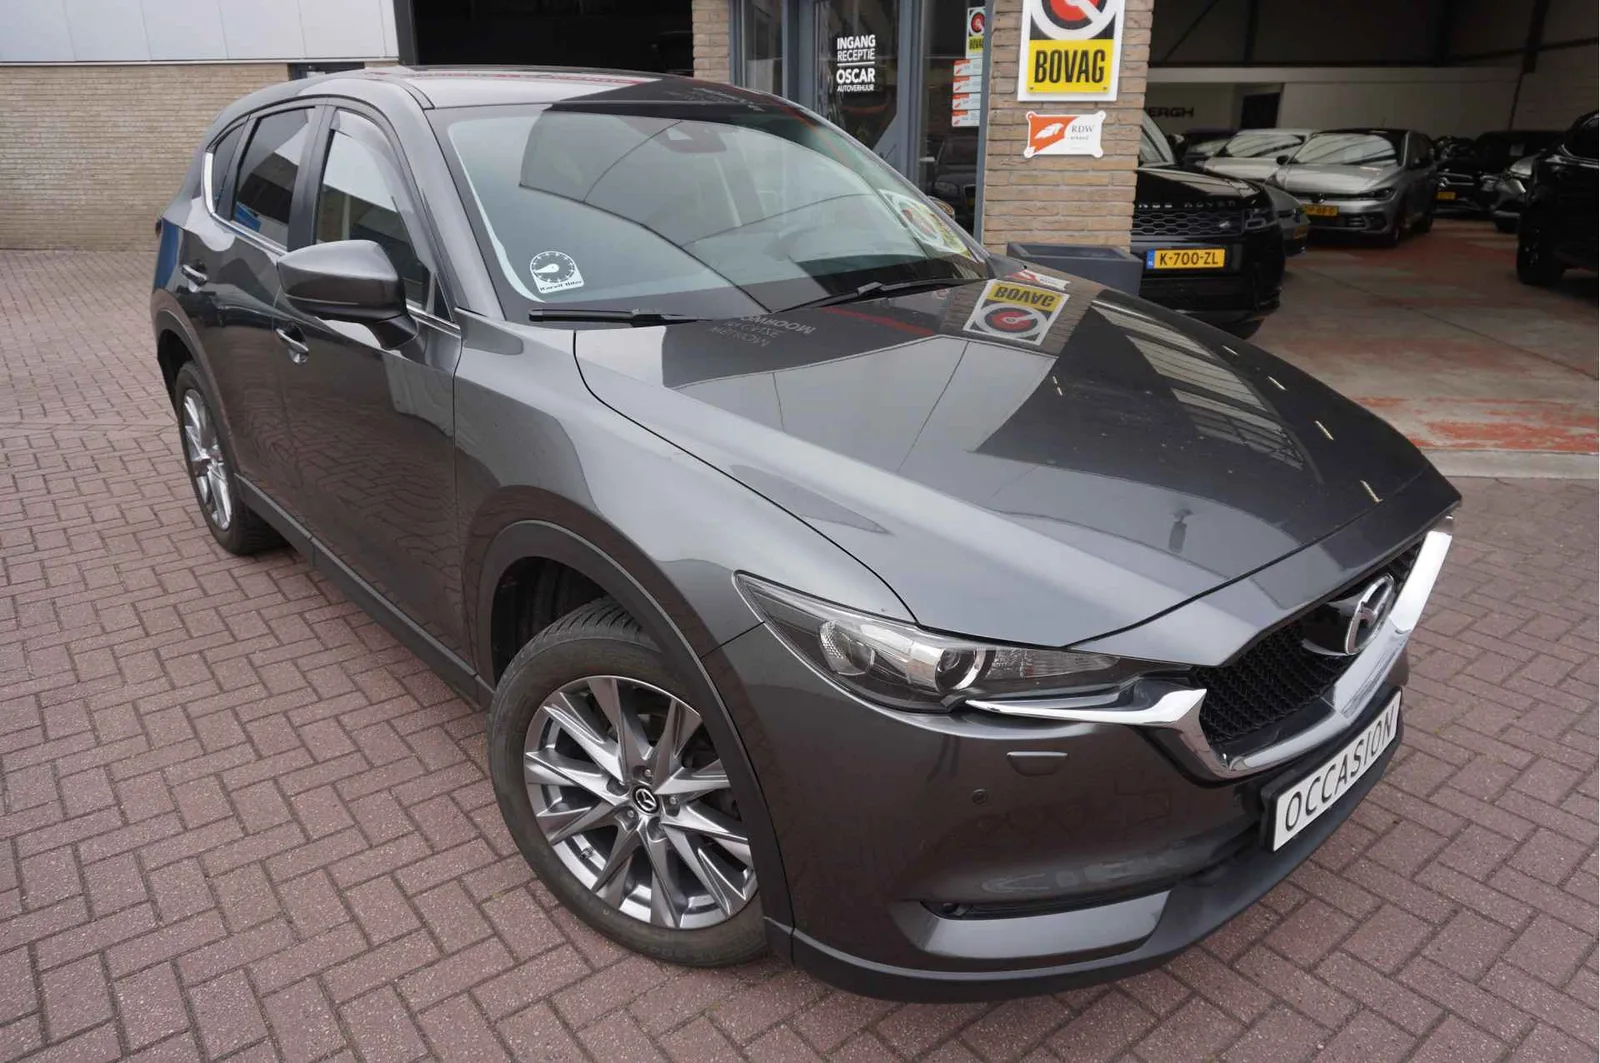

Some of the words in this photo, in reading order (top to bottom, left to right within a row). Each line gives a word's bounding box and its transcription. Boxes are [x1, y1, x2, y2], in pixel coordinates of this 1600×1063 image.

[837, 34, 876, 50] INGANG
[837, 48, 876, 62] RECEPTIE
[1034, 49, 1106, 84] BOVAG
[836, 67, 876, 84] OSCAR
[837, 83, 875, 92] AUTOVERHUUR
[1071, 124, 1095, 133] RDW
[1159, 251, 1219, 266] K-700-ZL
[1285, 704, 1395, 832] OCCASION
